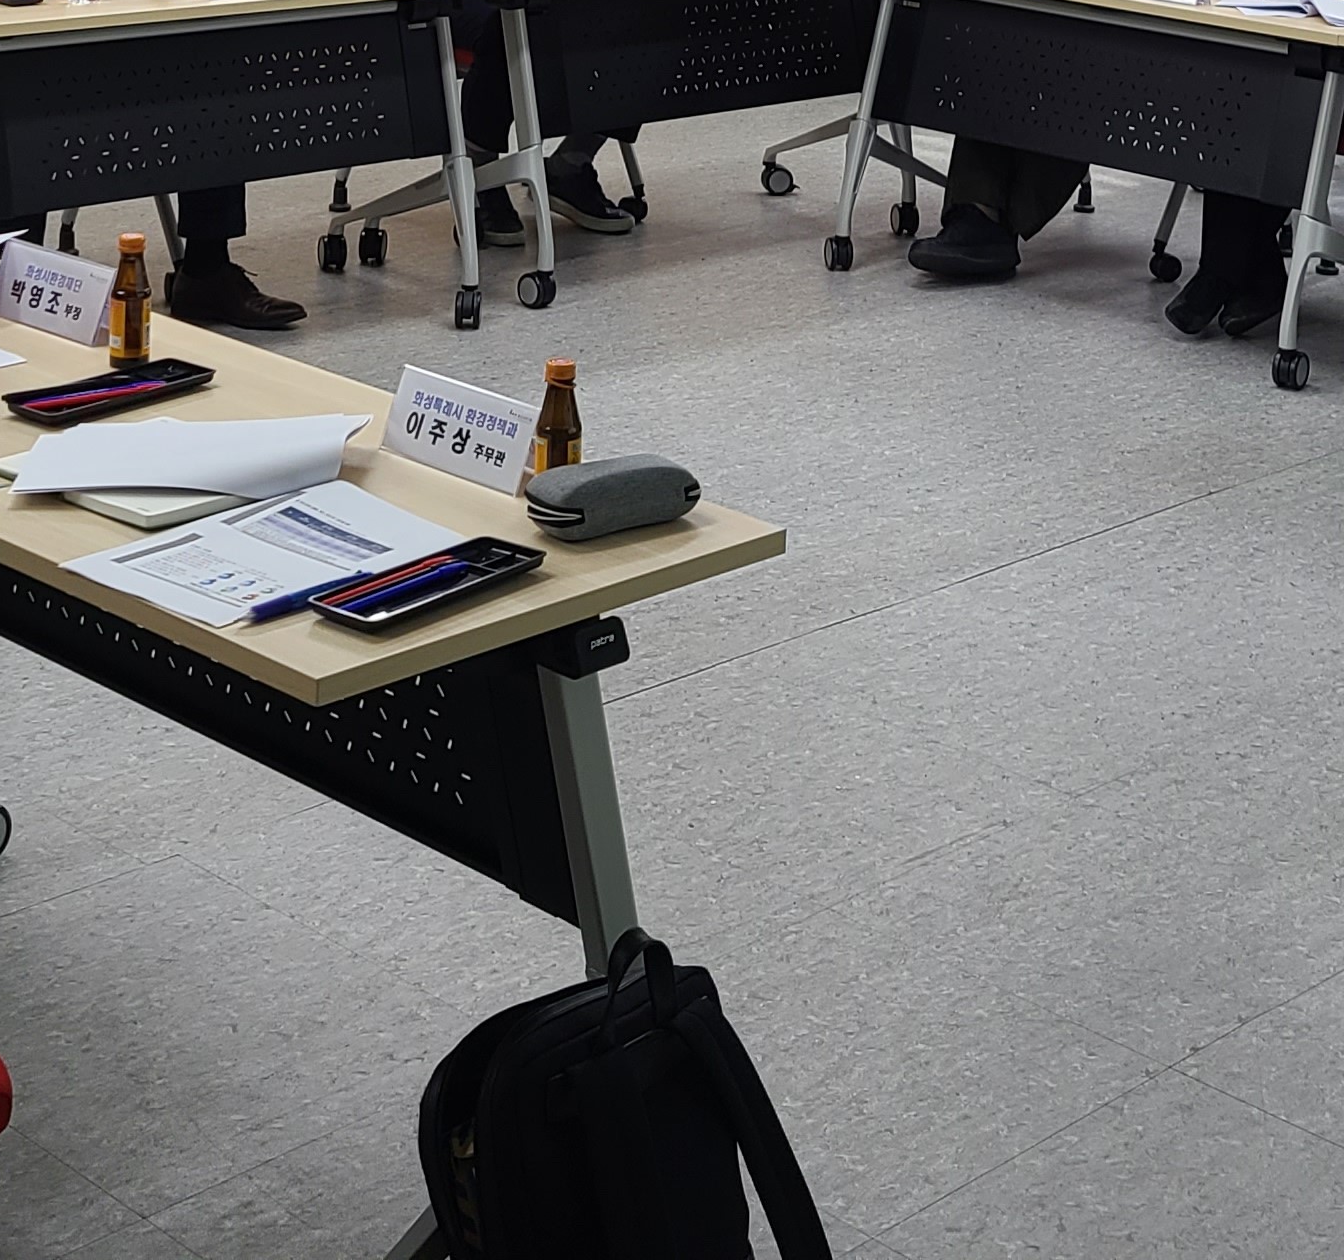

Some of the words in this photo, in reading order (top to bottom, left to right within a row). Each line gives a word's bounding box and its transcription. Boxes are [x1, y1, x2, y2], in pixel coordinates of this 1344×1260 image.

[10, 279, 63, 315] 박영조
[64, 303, 82, 321] 부장
[24, 265, 83, 293] 화성시환경재단
[412, 391, 465, 420] 화성특례시
[465, 408, 519, 439] 환경정책과
[406, 411, 471, 455] 이주상
[473, 443, 506, 468] 주무관
